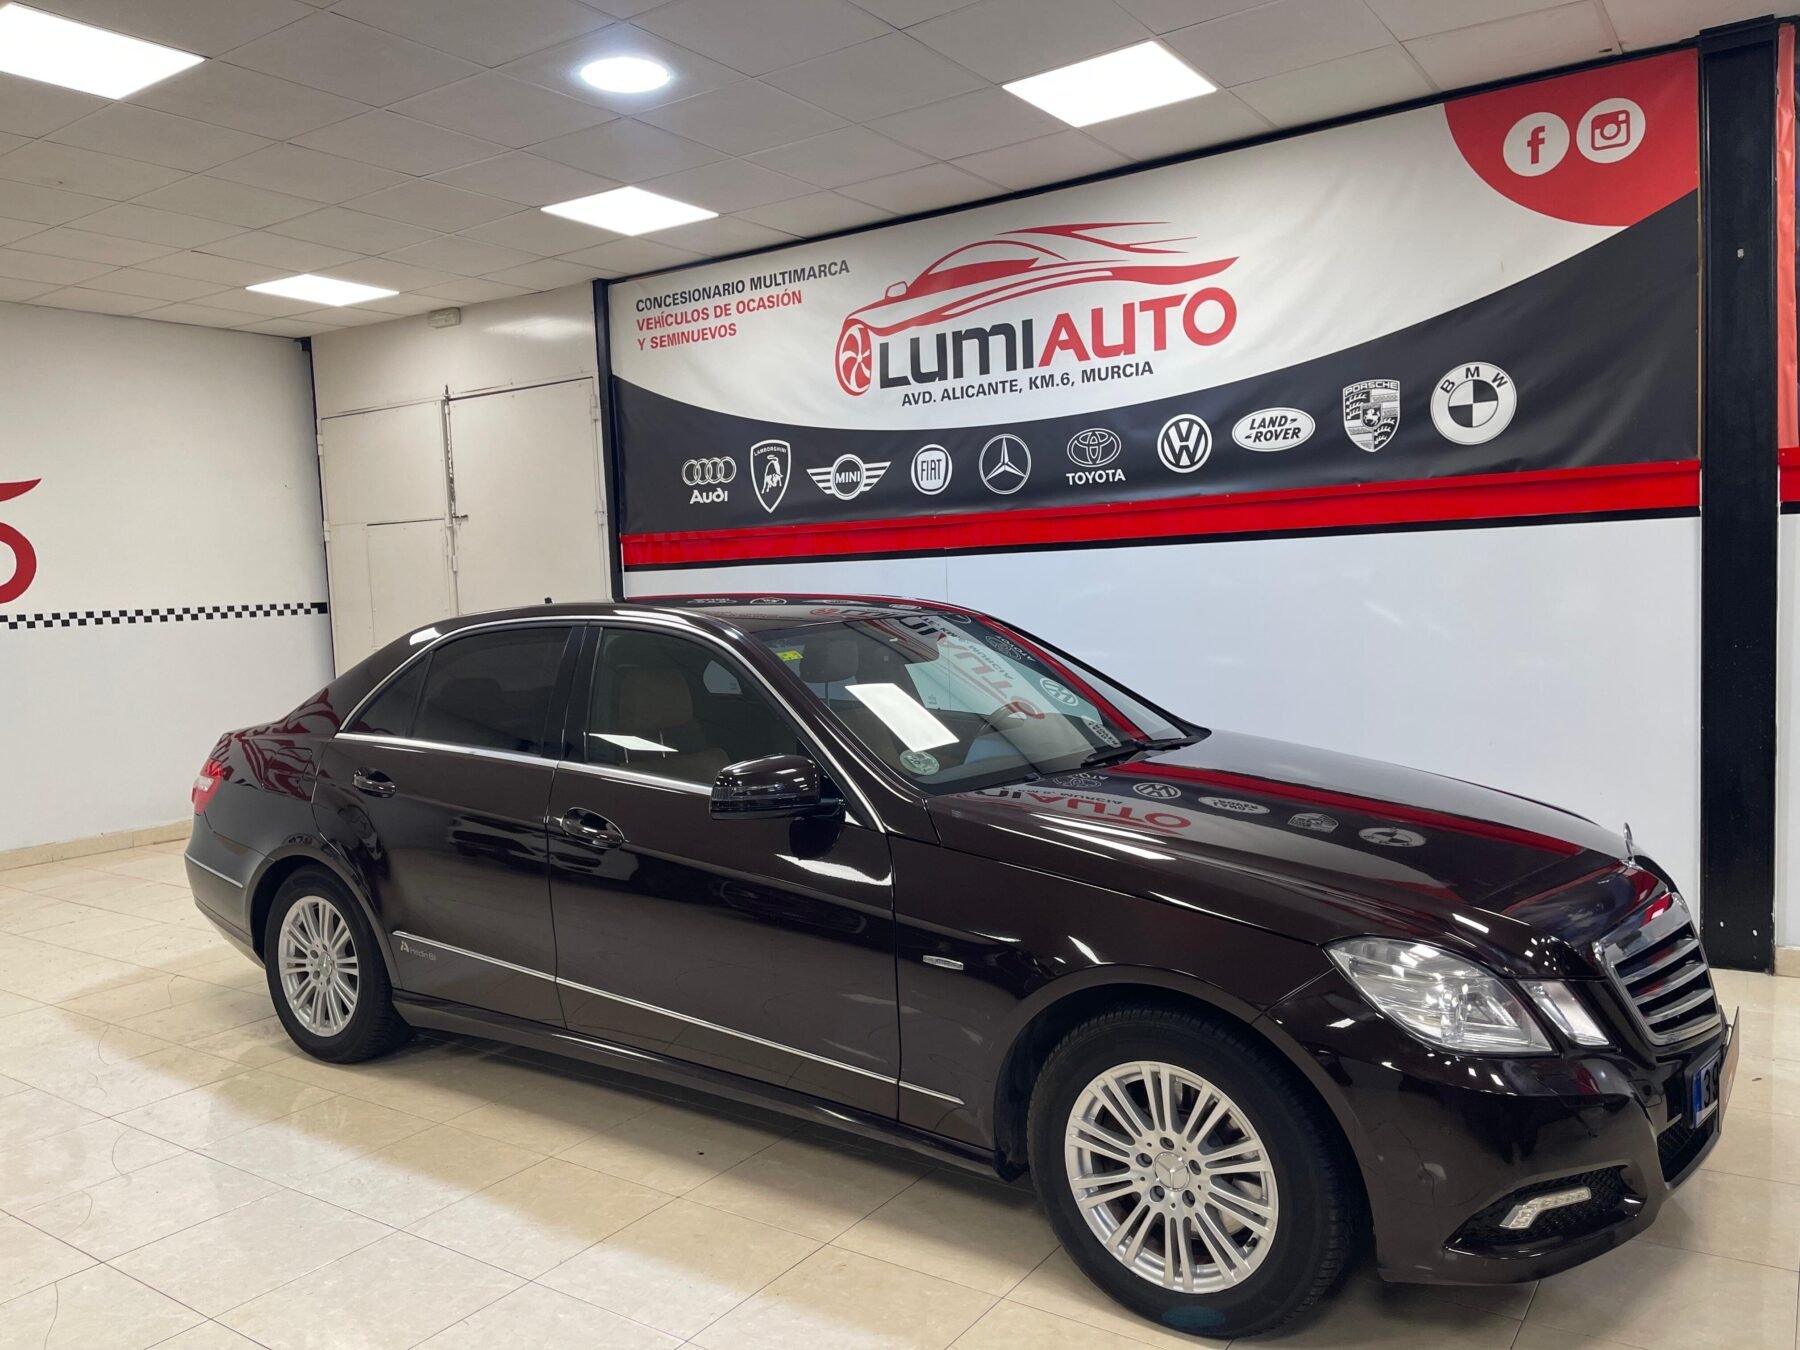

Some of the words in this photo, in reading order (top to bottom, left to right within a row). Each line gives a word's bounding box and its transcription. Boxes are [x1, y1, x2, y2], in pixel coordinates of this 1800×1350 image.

[636, 280, 745, 312] CONCESIONARIO
[749, 259, 850, 291] MULTIMARCA
[636, 306, 710, 332] VEHÍCULOS
[713, 303, 732, 319] DE
[735, 288, 803, 315] OCASIÓN
[637, 337, 646, 351] Y
[650, 322, 737, 350] SEMINUEVOS
[901, 390, 937, 407] AVD.
[940, 378, 1024, 402] ALICANTE,
[1028, 371, 1076, 391] KM.6,
[1080, 360, 1154, 384] MURCIA
[1344, 380, 1399, 397] PORSCHE
[834, 470, 862, 484] MINI
[920, 458, 943, 483] FIAT
[1065, 468, 1127, 486] TOYOTA
[689, 487, 729, 505] Audi
